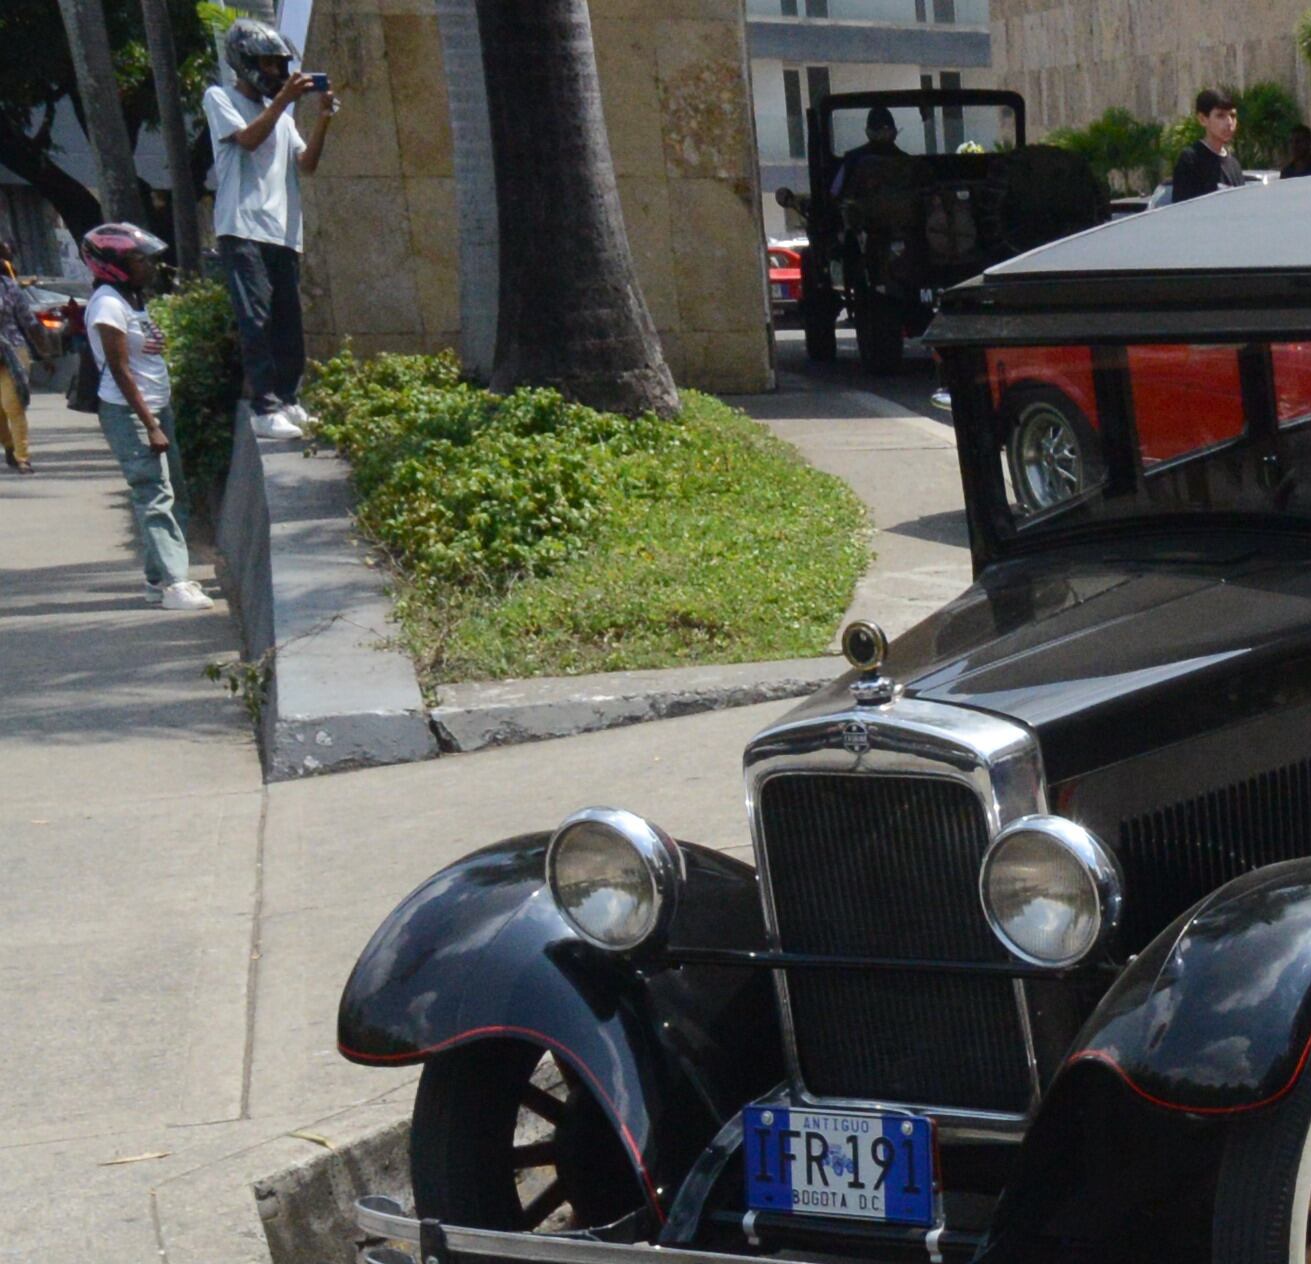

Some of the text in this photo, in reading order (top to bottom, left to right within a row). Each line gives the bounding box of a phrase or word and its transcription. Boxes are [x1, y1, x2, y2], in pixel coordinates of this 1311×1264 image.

[803, 1117, 870, 1133] ANTIGUO
[755, 1128, 920, 1194] IFR 191
[792, 1189, 848, 1208] BOGOTA
